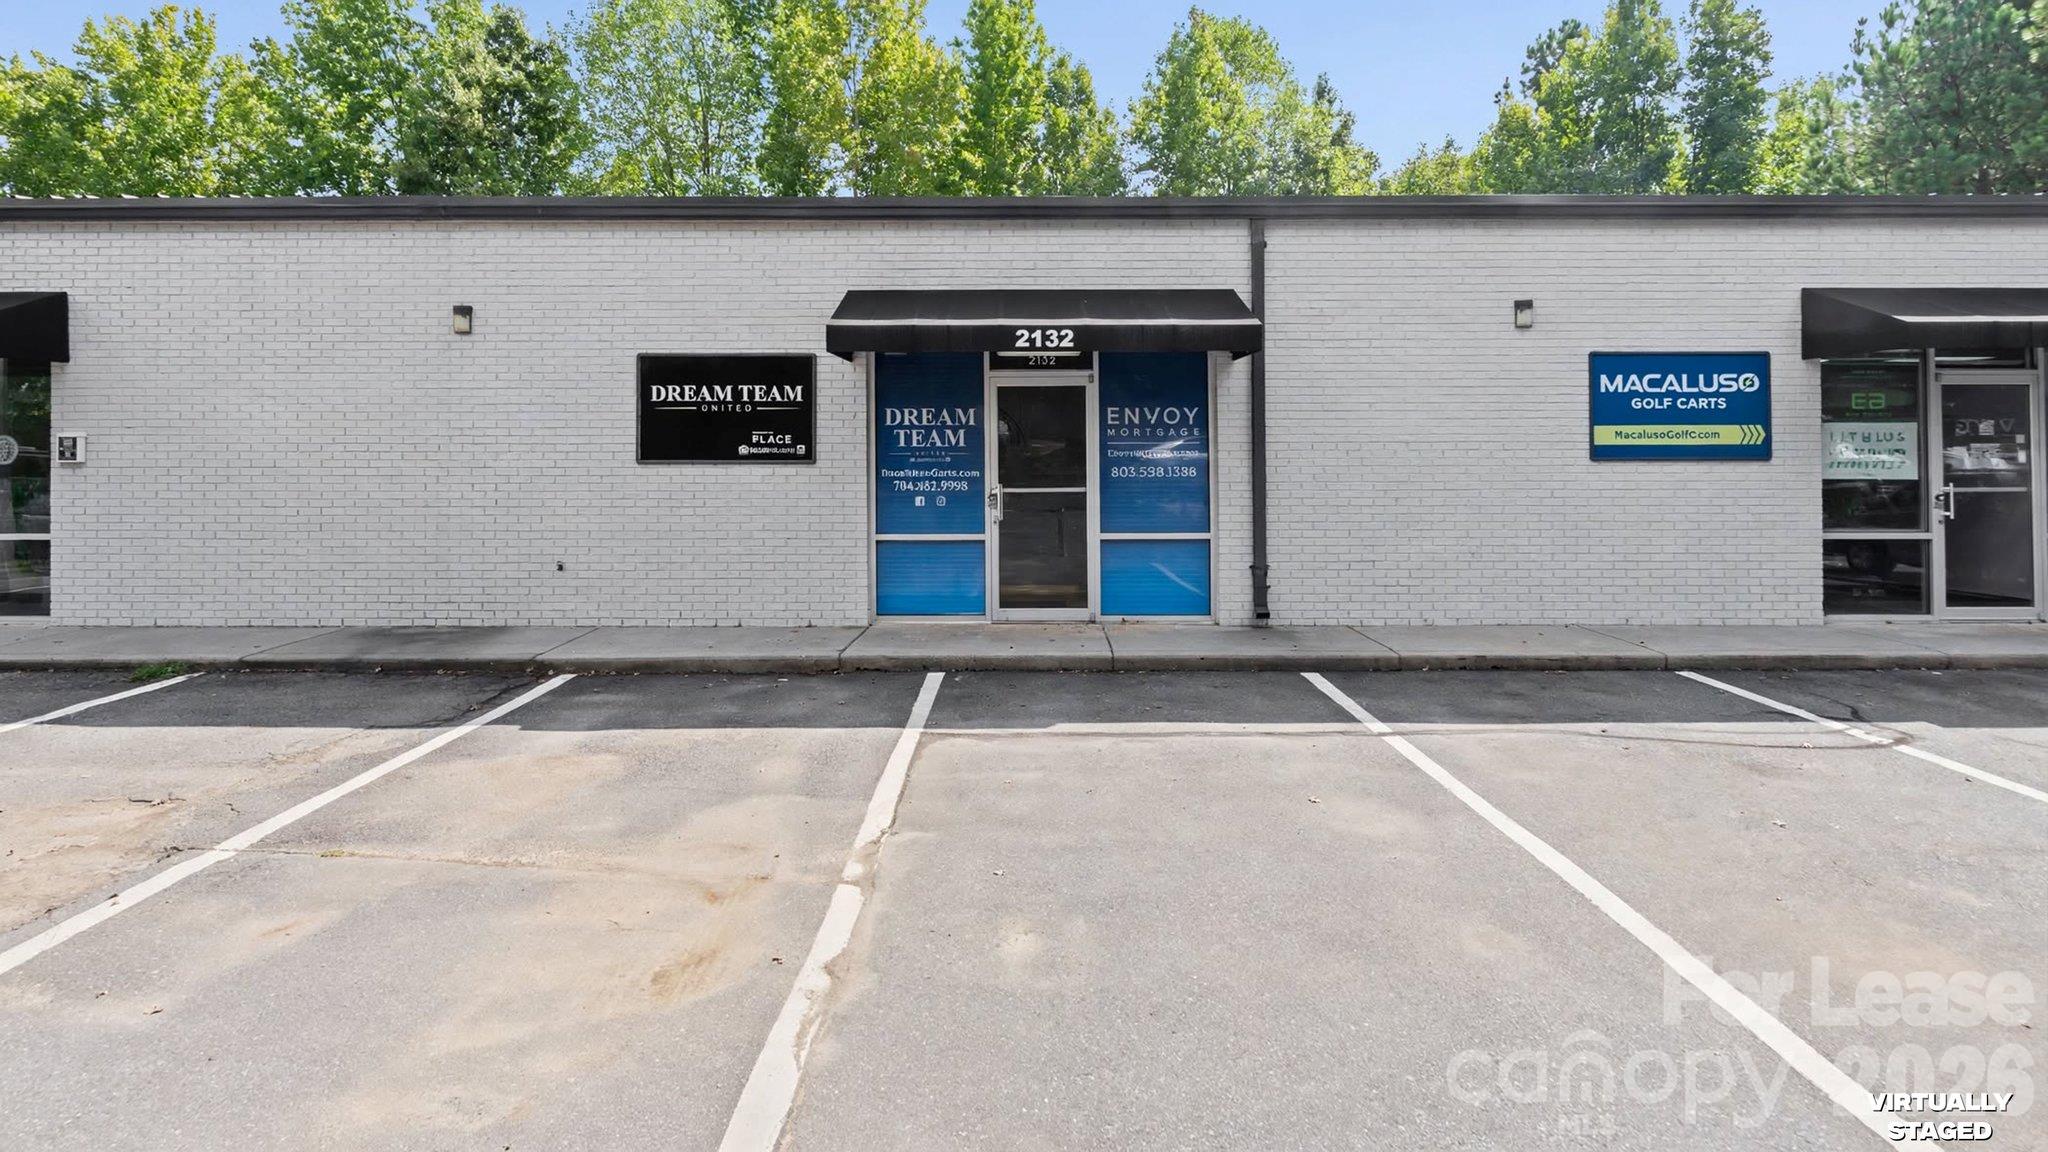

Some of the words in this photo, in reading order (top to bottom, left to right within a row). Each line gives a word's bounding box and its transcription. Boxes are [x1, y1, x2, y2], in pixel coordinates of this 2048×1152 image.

[1014, 328, 1075, 348] 2132
[1028, 356, 1056, 366] 2132
[1600, 373, 1760, 393] MACALUSO
[650, 384, 734, 402] DREAM
[737, 384, 804, 402] TEAM
[1631, 397, 1673, 410] GOLF
[1676, 397, 1727, 410] CARTS
[885, 408, 976, 426] DREAM
[1107, 407, 1199, 425] ENVOY
[894, 429, 967, 447] TEAM
[1107, 428, 1200, 437] MORTGAGE
